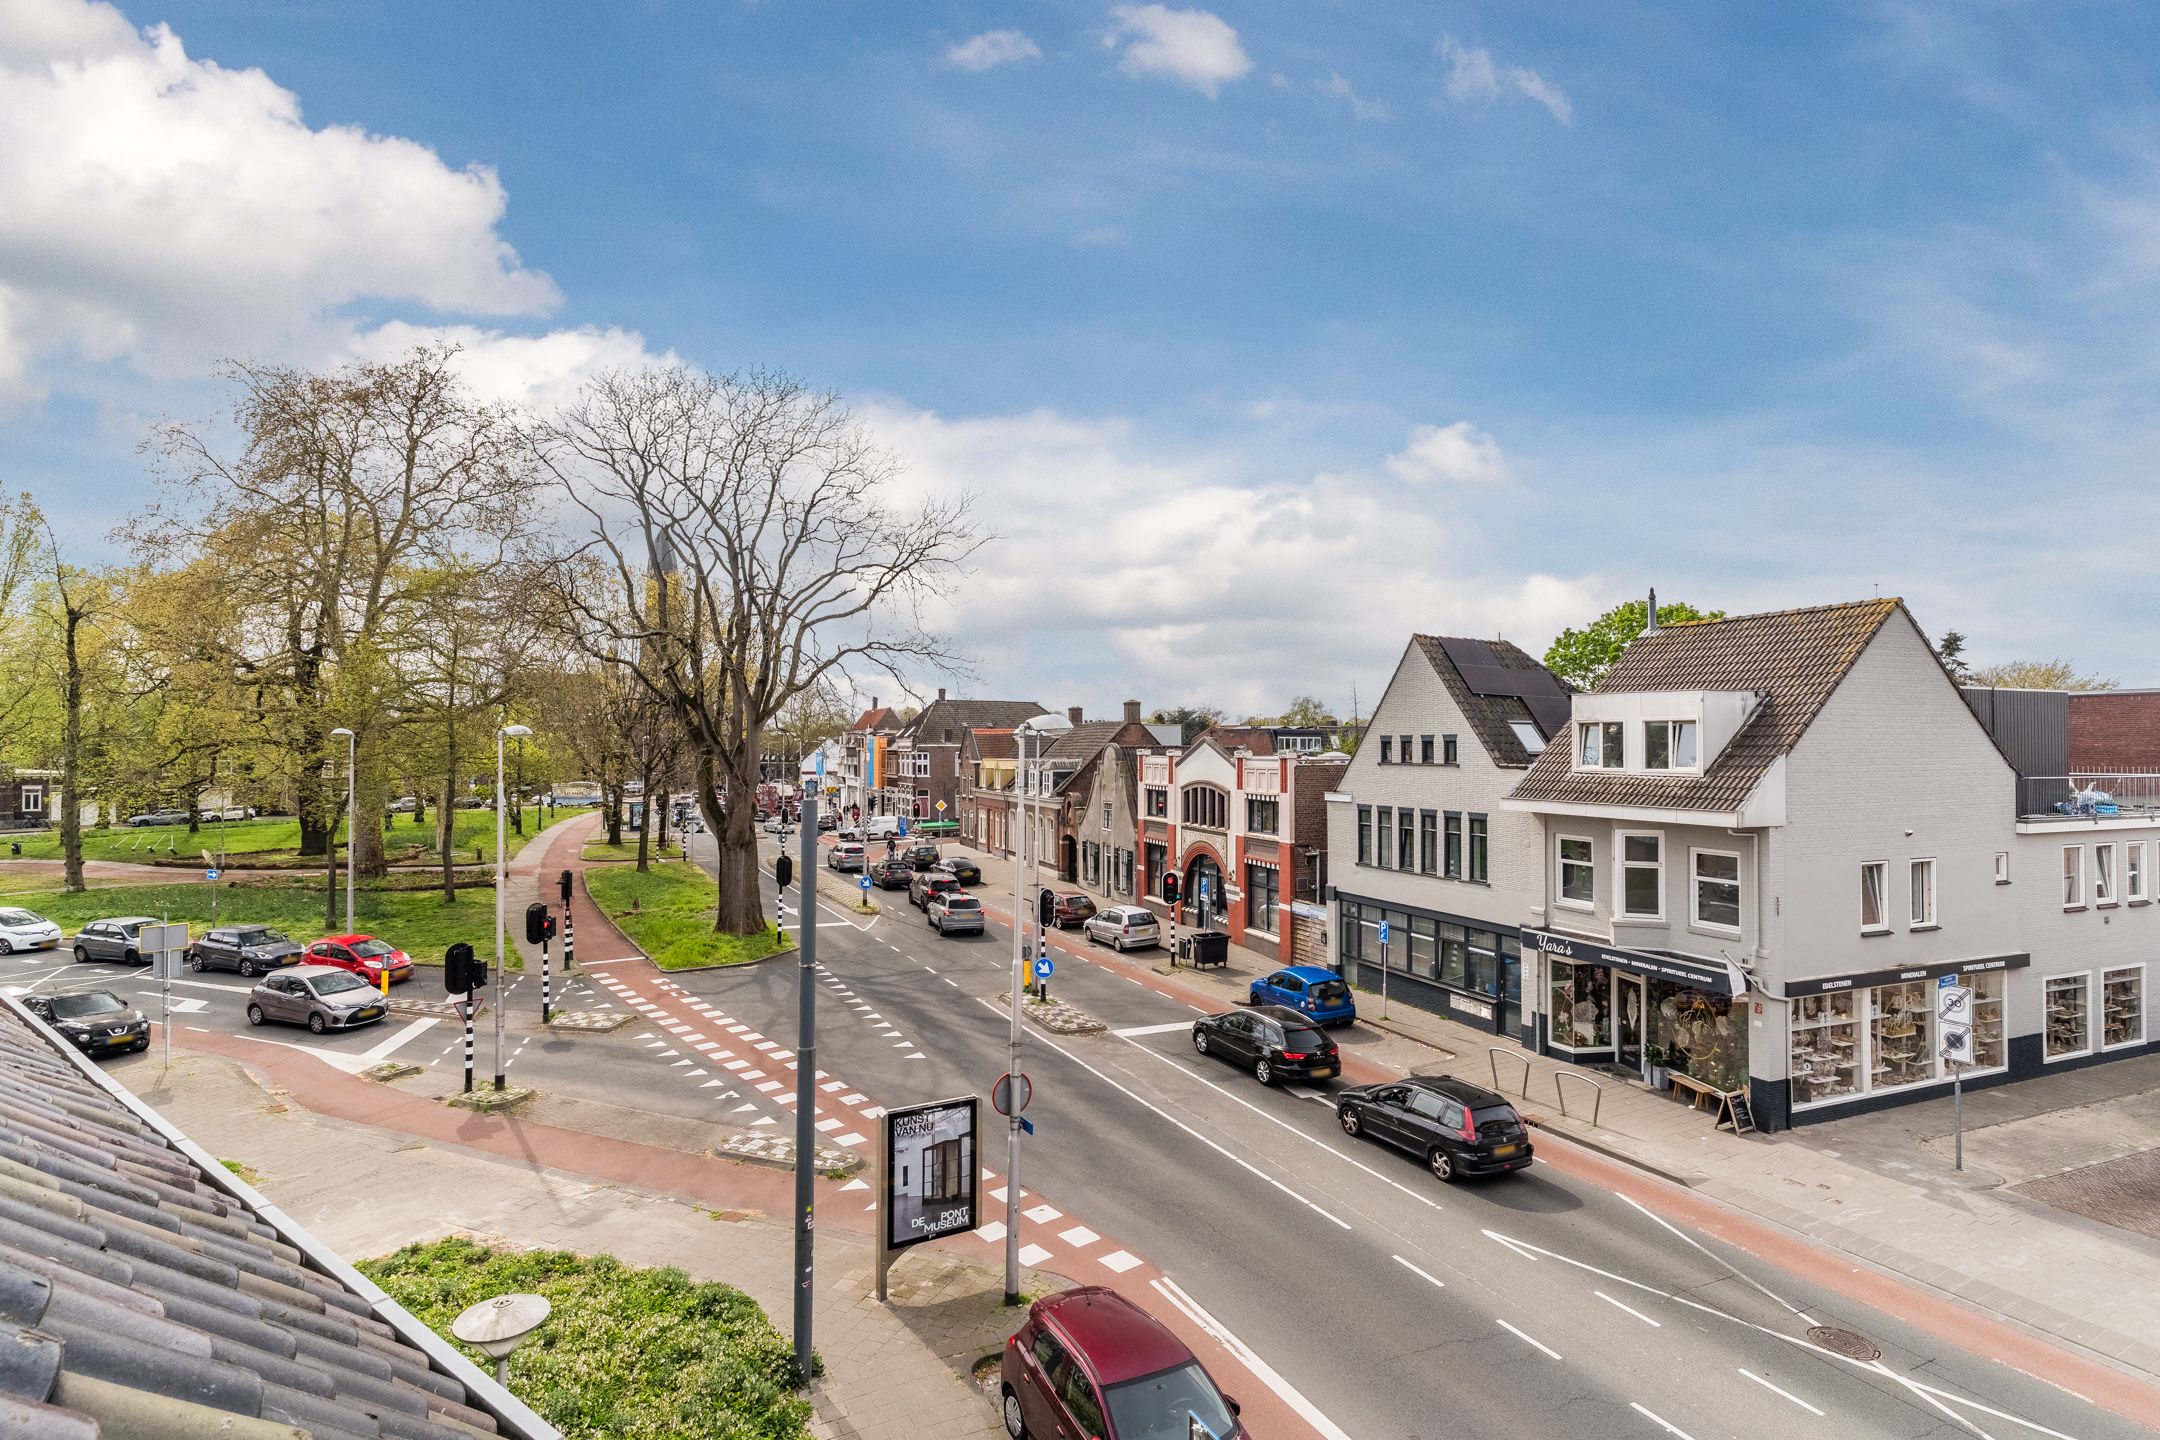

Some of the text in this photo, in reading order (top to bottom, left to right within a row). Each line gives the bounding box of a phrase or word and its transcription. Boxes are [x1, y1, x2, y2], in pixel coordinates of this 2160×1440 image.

[1381, 922, 1386, 932] P
[1536, 934, 1573, 955] Yara's
[1631, 960, 1658, 971] MINERALEN
[1661, 967, 1687, 978] SPIRITUEEL
[1687, 973, 1713, 983] CENTRUM
[1985, 961, 2006, 969] CENTRUM
[1900, 970, 1927, 980] MINERALEN
[1822, 980, 1852, 990] EDELSTENEN
[1947, 998, 1962, 1008] 30
[895, 1114, 930, 1128] KUNST
[895, 1122, 934, 1137] VAN NU
[911, 1206, 969, 1229] DE PONT
[923, 1214, 969, 1234] MUSEUM
